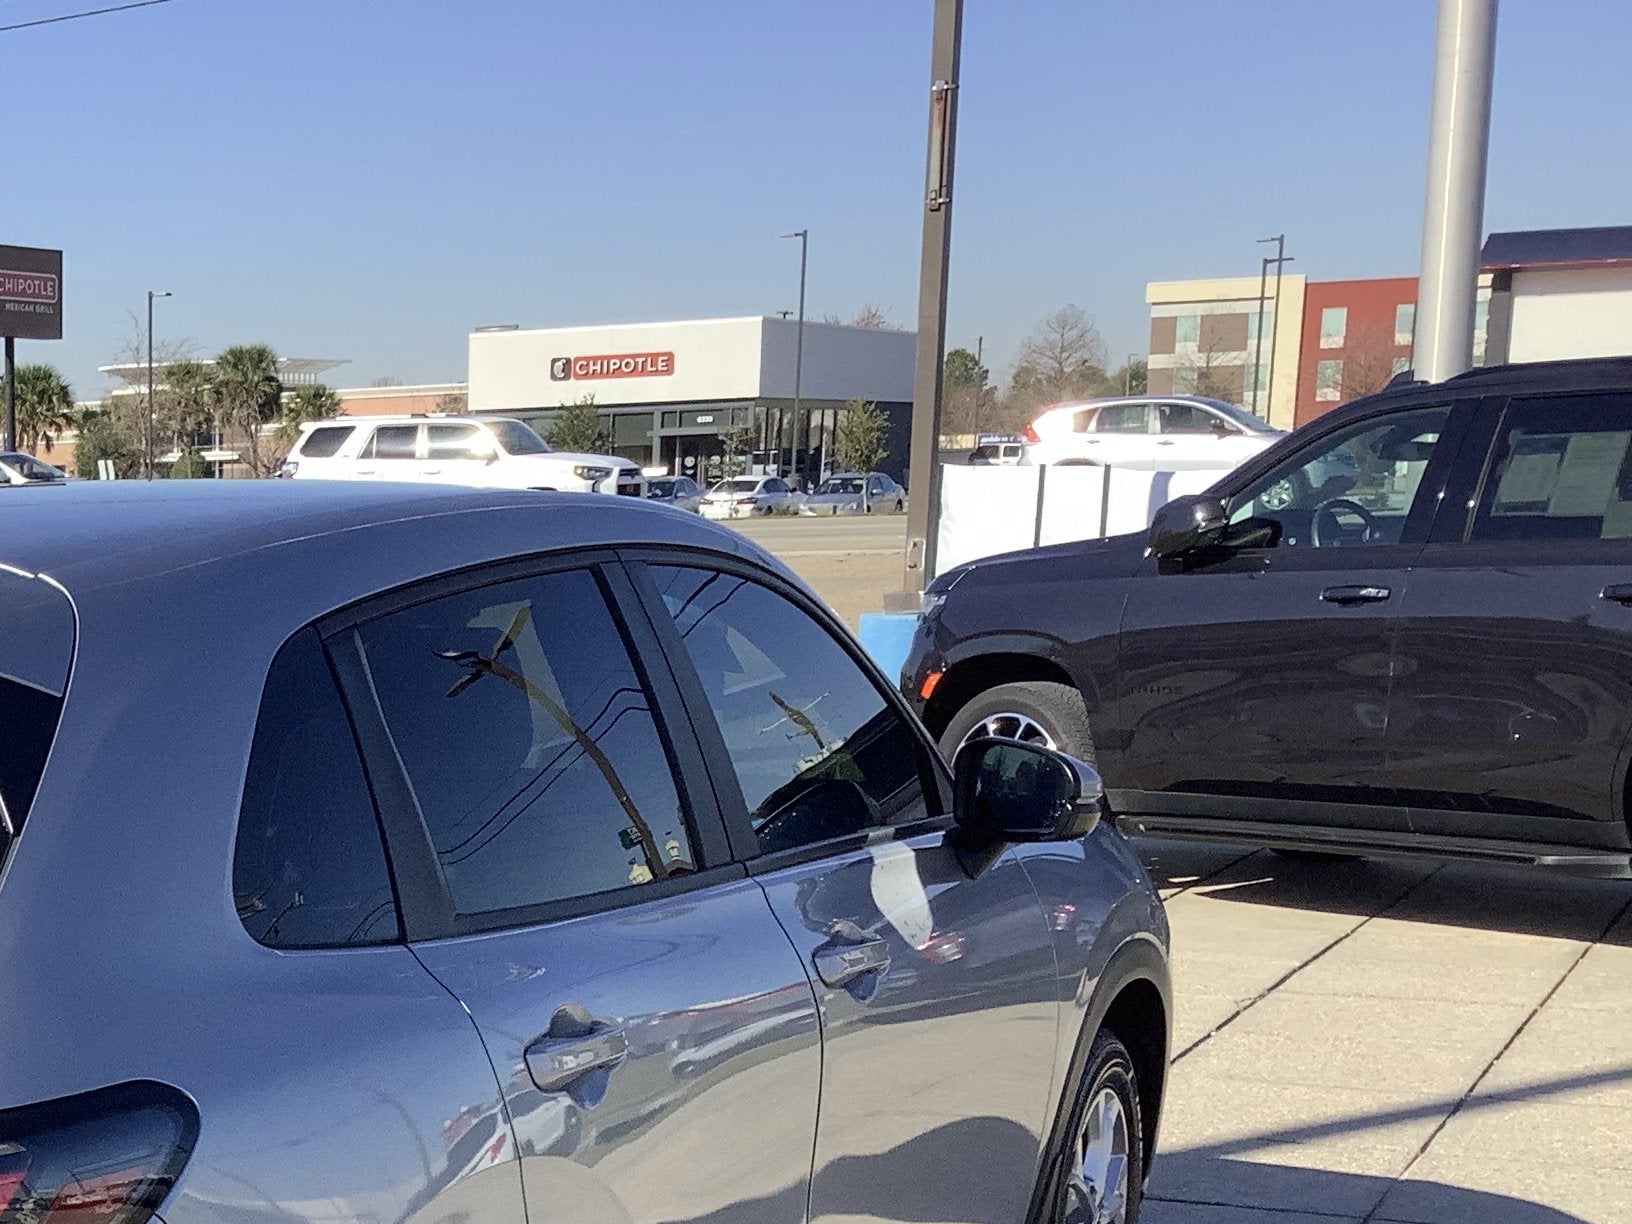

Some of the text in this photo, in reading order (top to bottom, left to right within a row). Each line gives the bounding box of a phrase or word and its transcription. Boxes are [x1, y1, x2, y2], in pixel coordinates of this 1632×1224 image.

[5, 302, 54, 314] MEXICAN GRILL
[575, 356, 669, 376] CHIPOTLE
